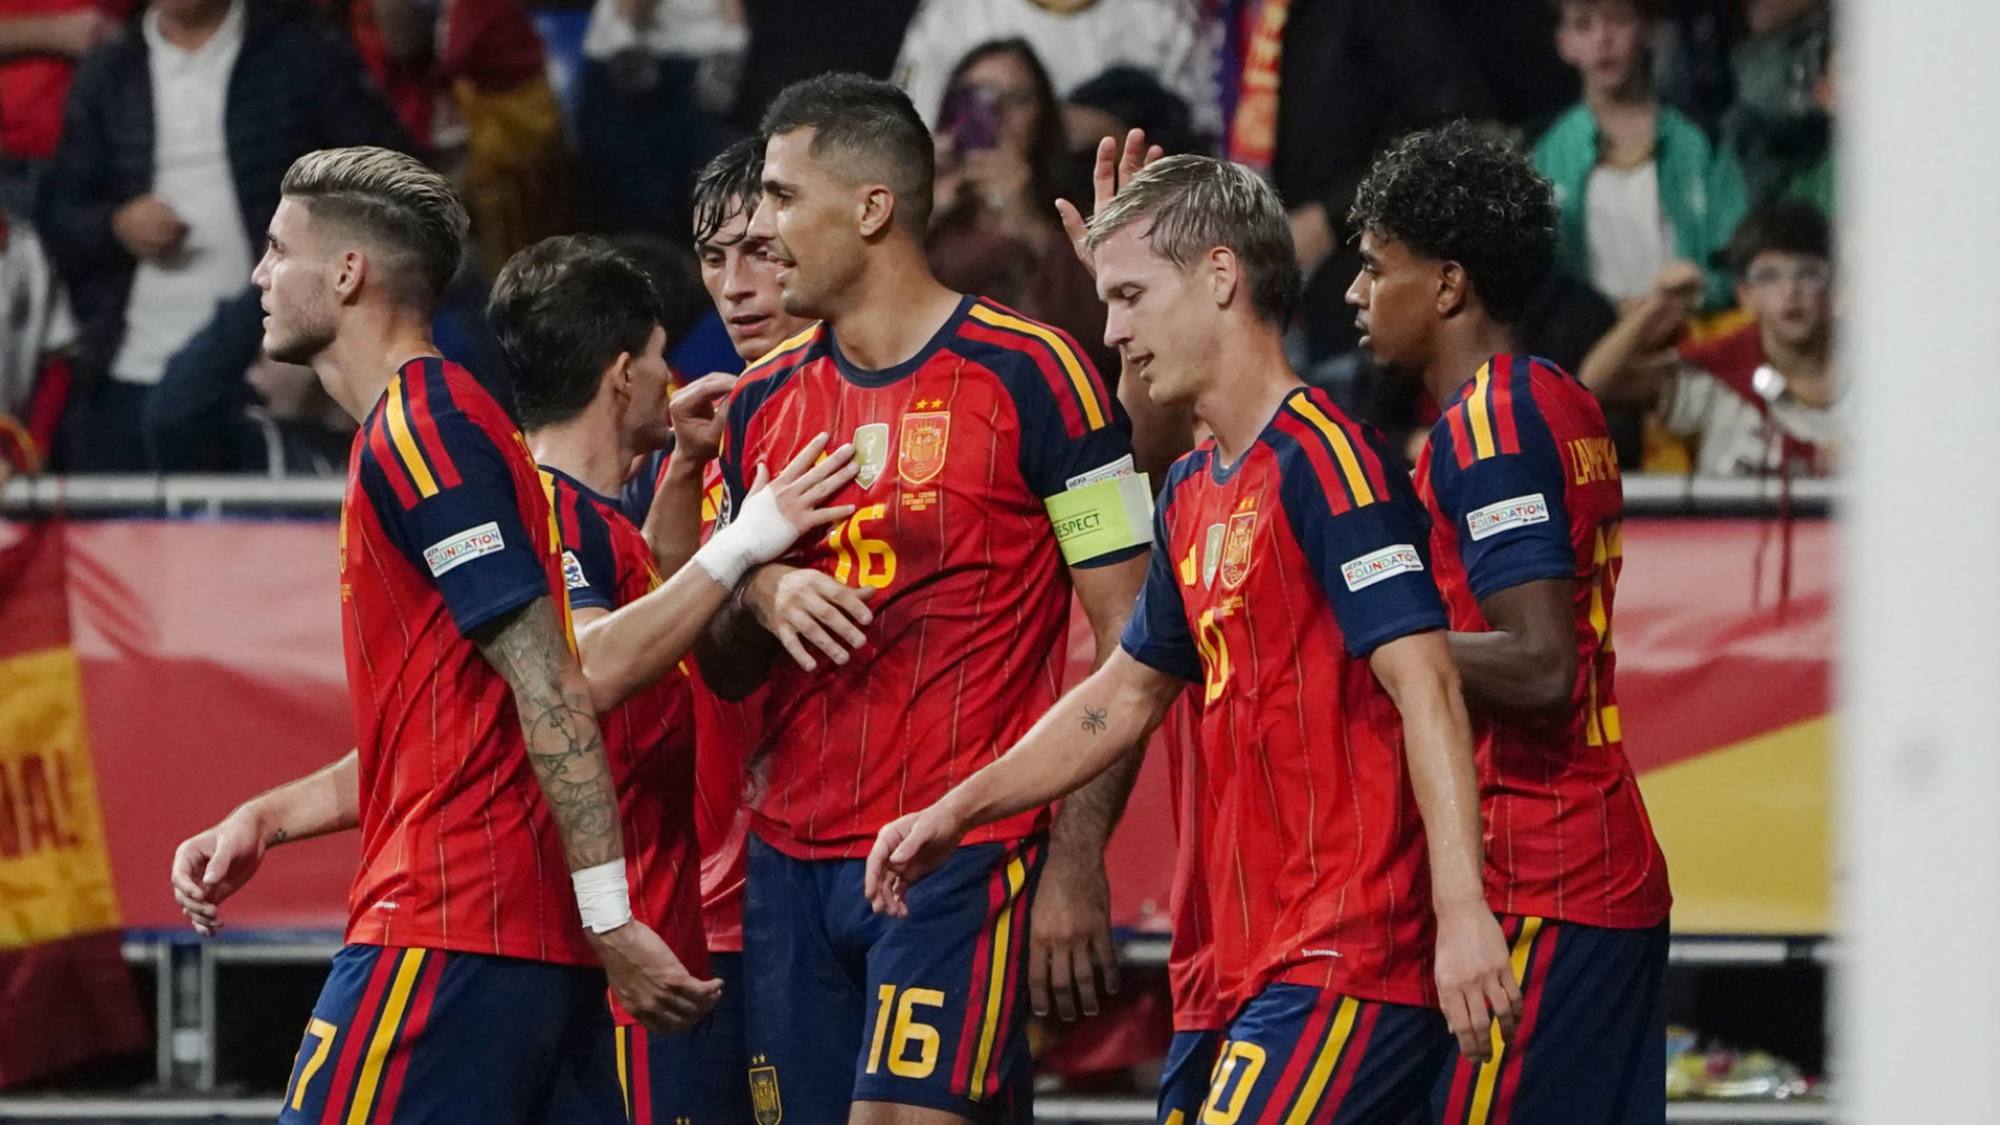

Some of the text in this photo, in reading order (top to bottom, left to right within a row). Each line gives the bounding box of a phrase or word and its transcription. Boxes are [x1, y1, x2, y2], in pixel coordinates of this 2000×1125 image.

[828, 503, 897, 589] 16
[1055, 513, 1100, 538] ESPECT
[1470, 504, 1545, 529] FOUNDATION
[428, 530, 500, 567] FOUNDATION
[865, 983, 945, 1079] 16
[288, 1017, 338, 1112] 7
